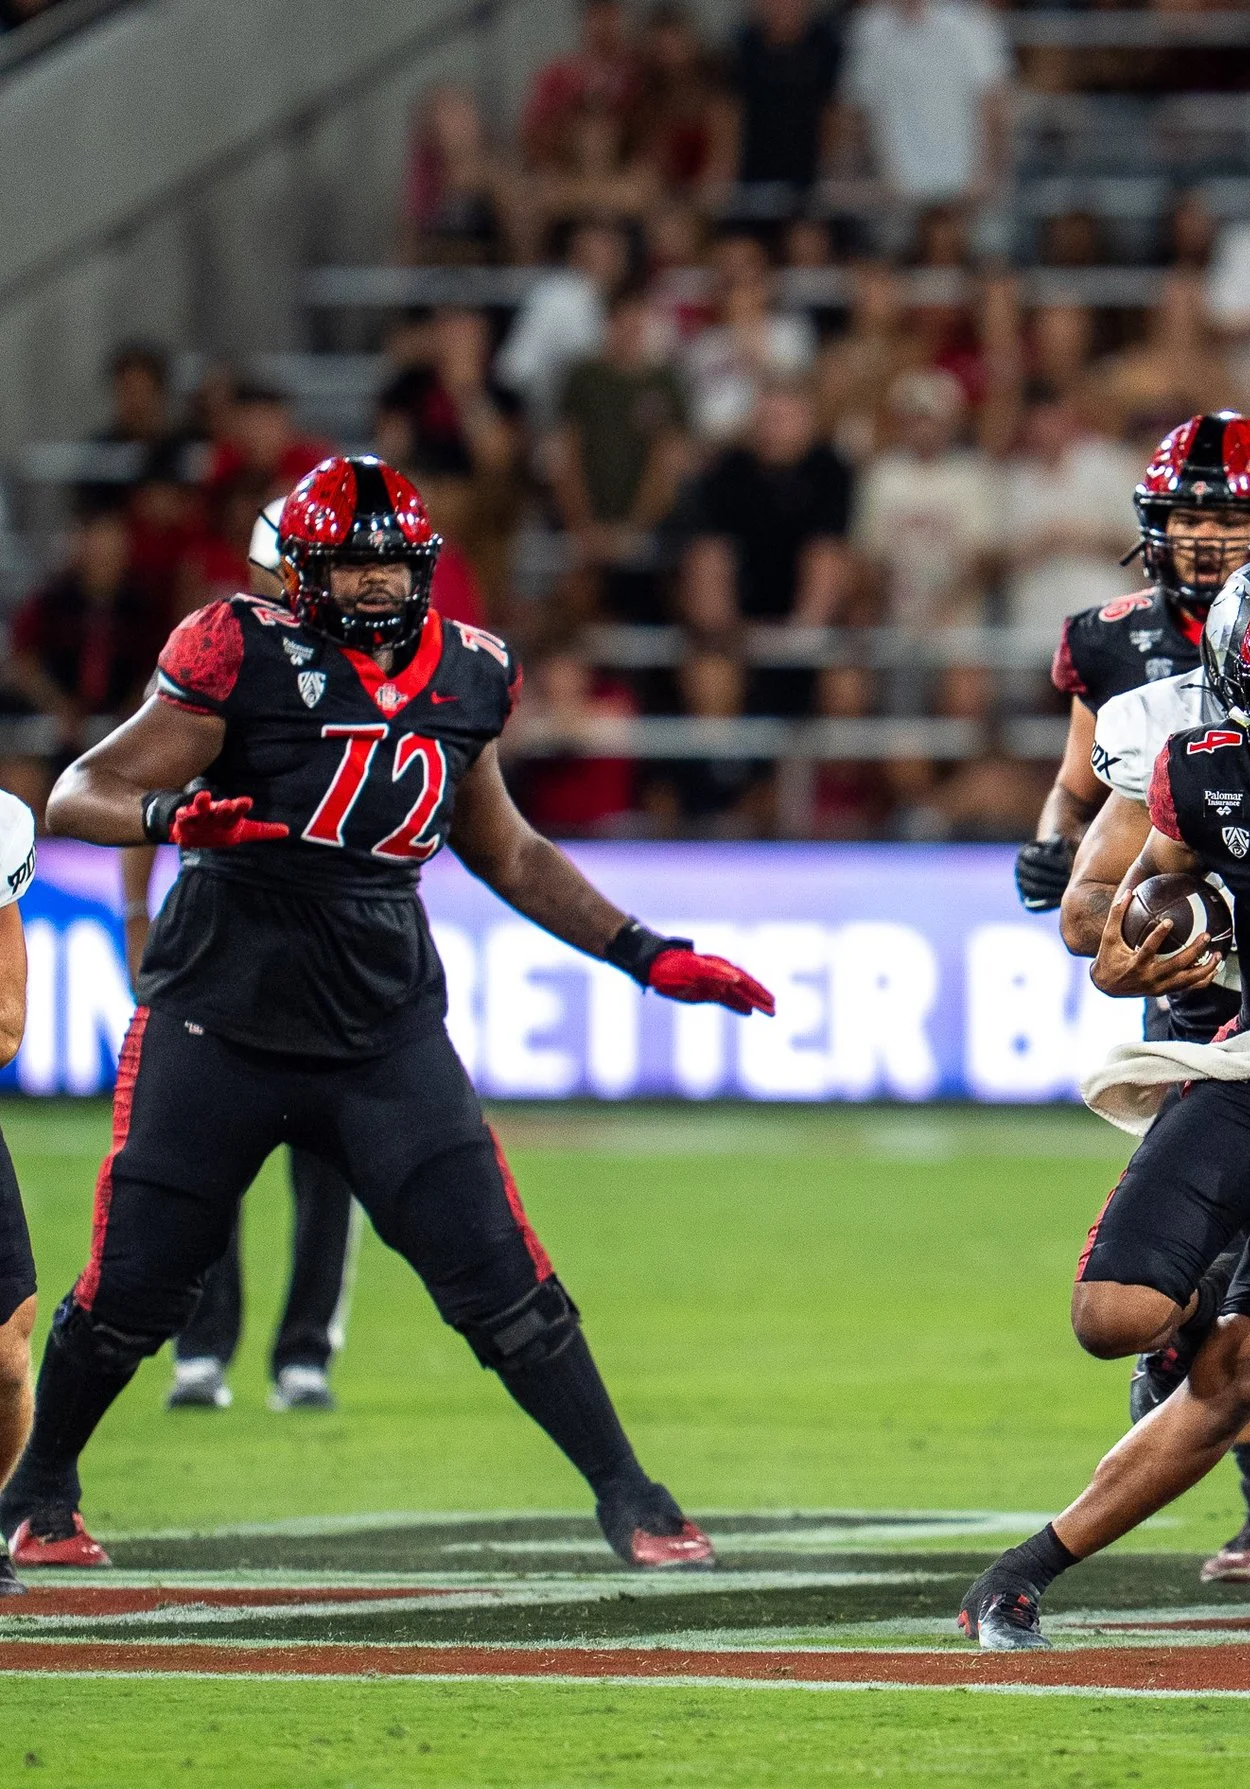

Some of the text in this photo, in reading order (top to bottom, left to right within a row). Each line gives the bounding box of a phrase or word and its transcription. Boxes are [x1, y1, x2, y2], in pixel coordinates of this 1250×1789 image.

[1187, 730, 1243, 755] 4
[1091, 740, 1122, 780] DX
[301, 723, 447, 861] 72
[1204, 790, 1244, 801] Palomar
[1207, 799, 1241, 807] Insurance
